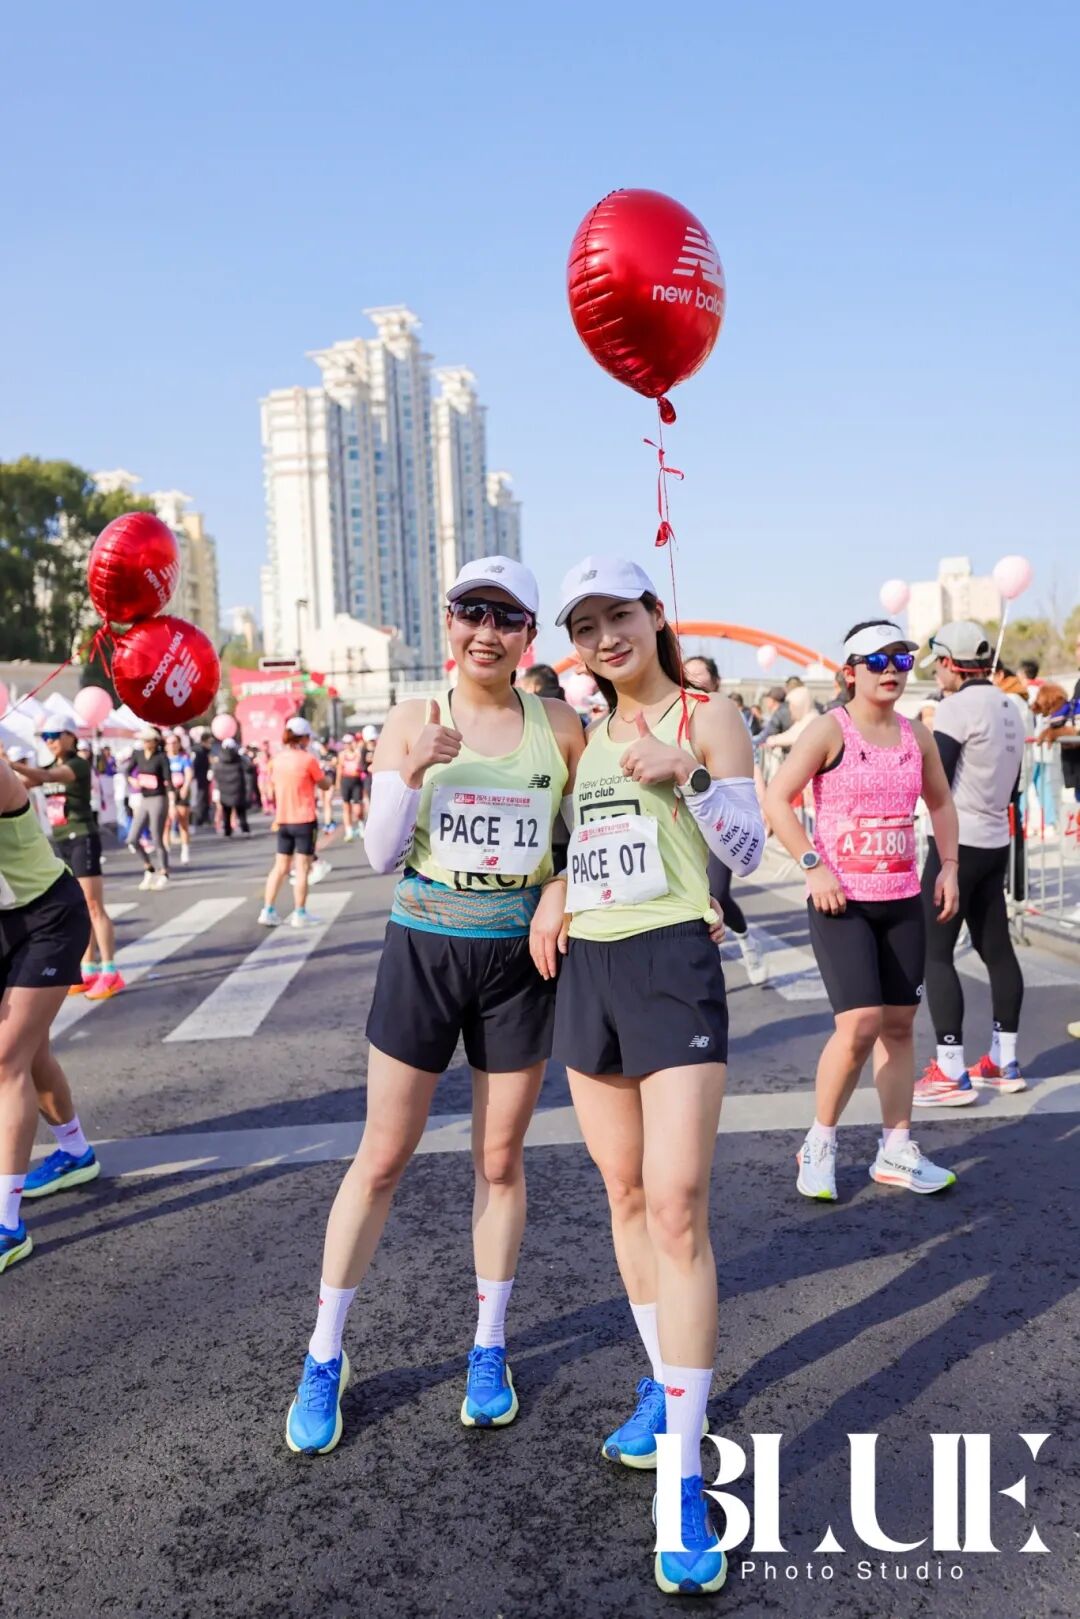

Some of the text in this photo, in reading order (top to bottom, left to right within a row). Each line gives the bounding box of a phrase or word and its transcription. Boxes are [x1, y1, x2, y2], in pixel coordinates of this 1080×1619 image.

[652, 284, 692, 304] new
[142, 631, 184, 698] new balance
[579, 786, 615, 801] run club
[580, 779, 597, 791] new
[440, 813, 539, 847] PACE 12
[730, 829, 750, 857] your
[842, 831, 906, 856] A 2180
[572, 842, 646, 884] PACE 07
[741, 838, 759, 866] Run
